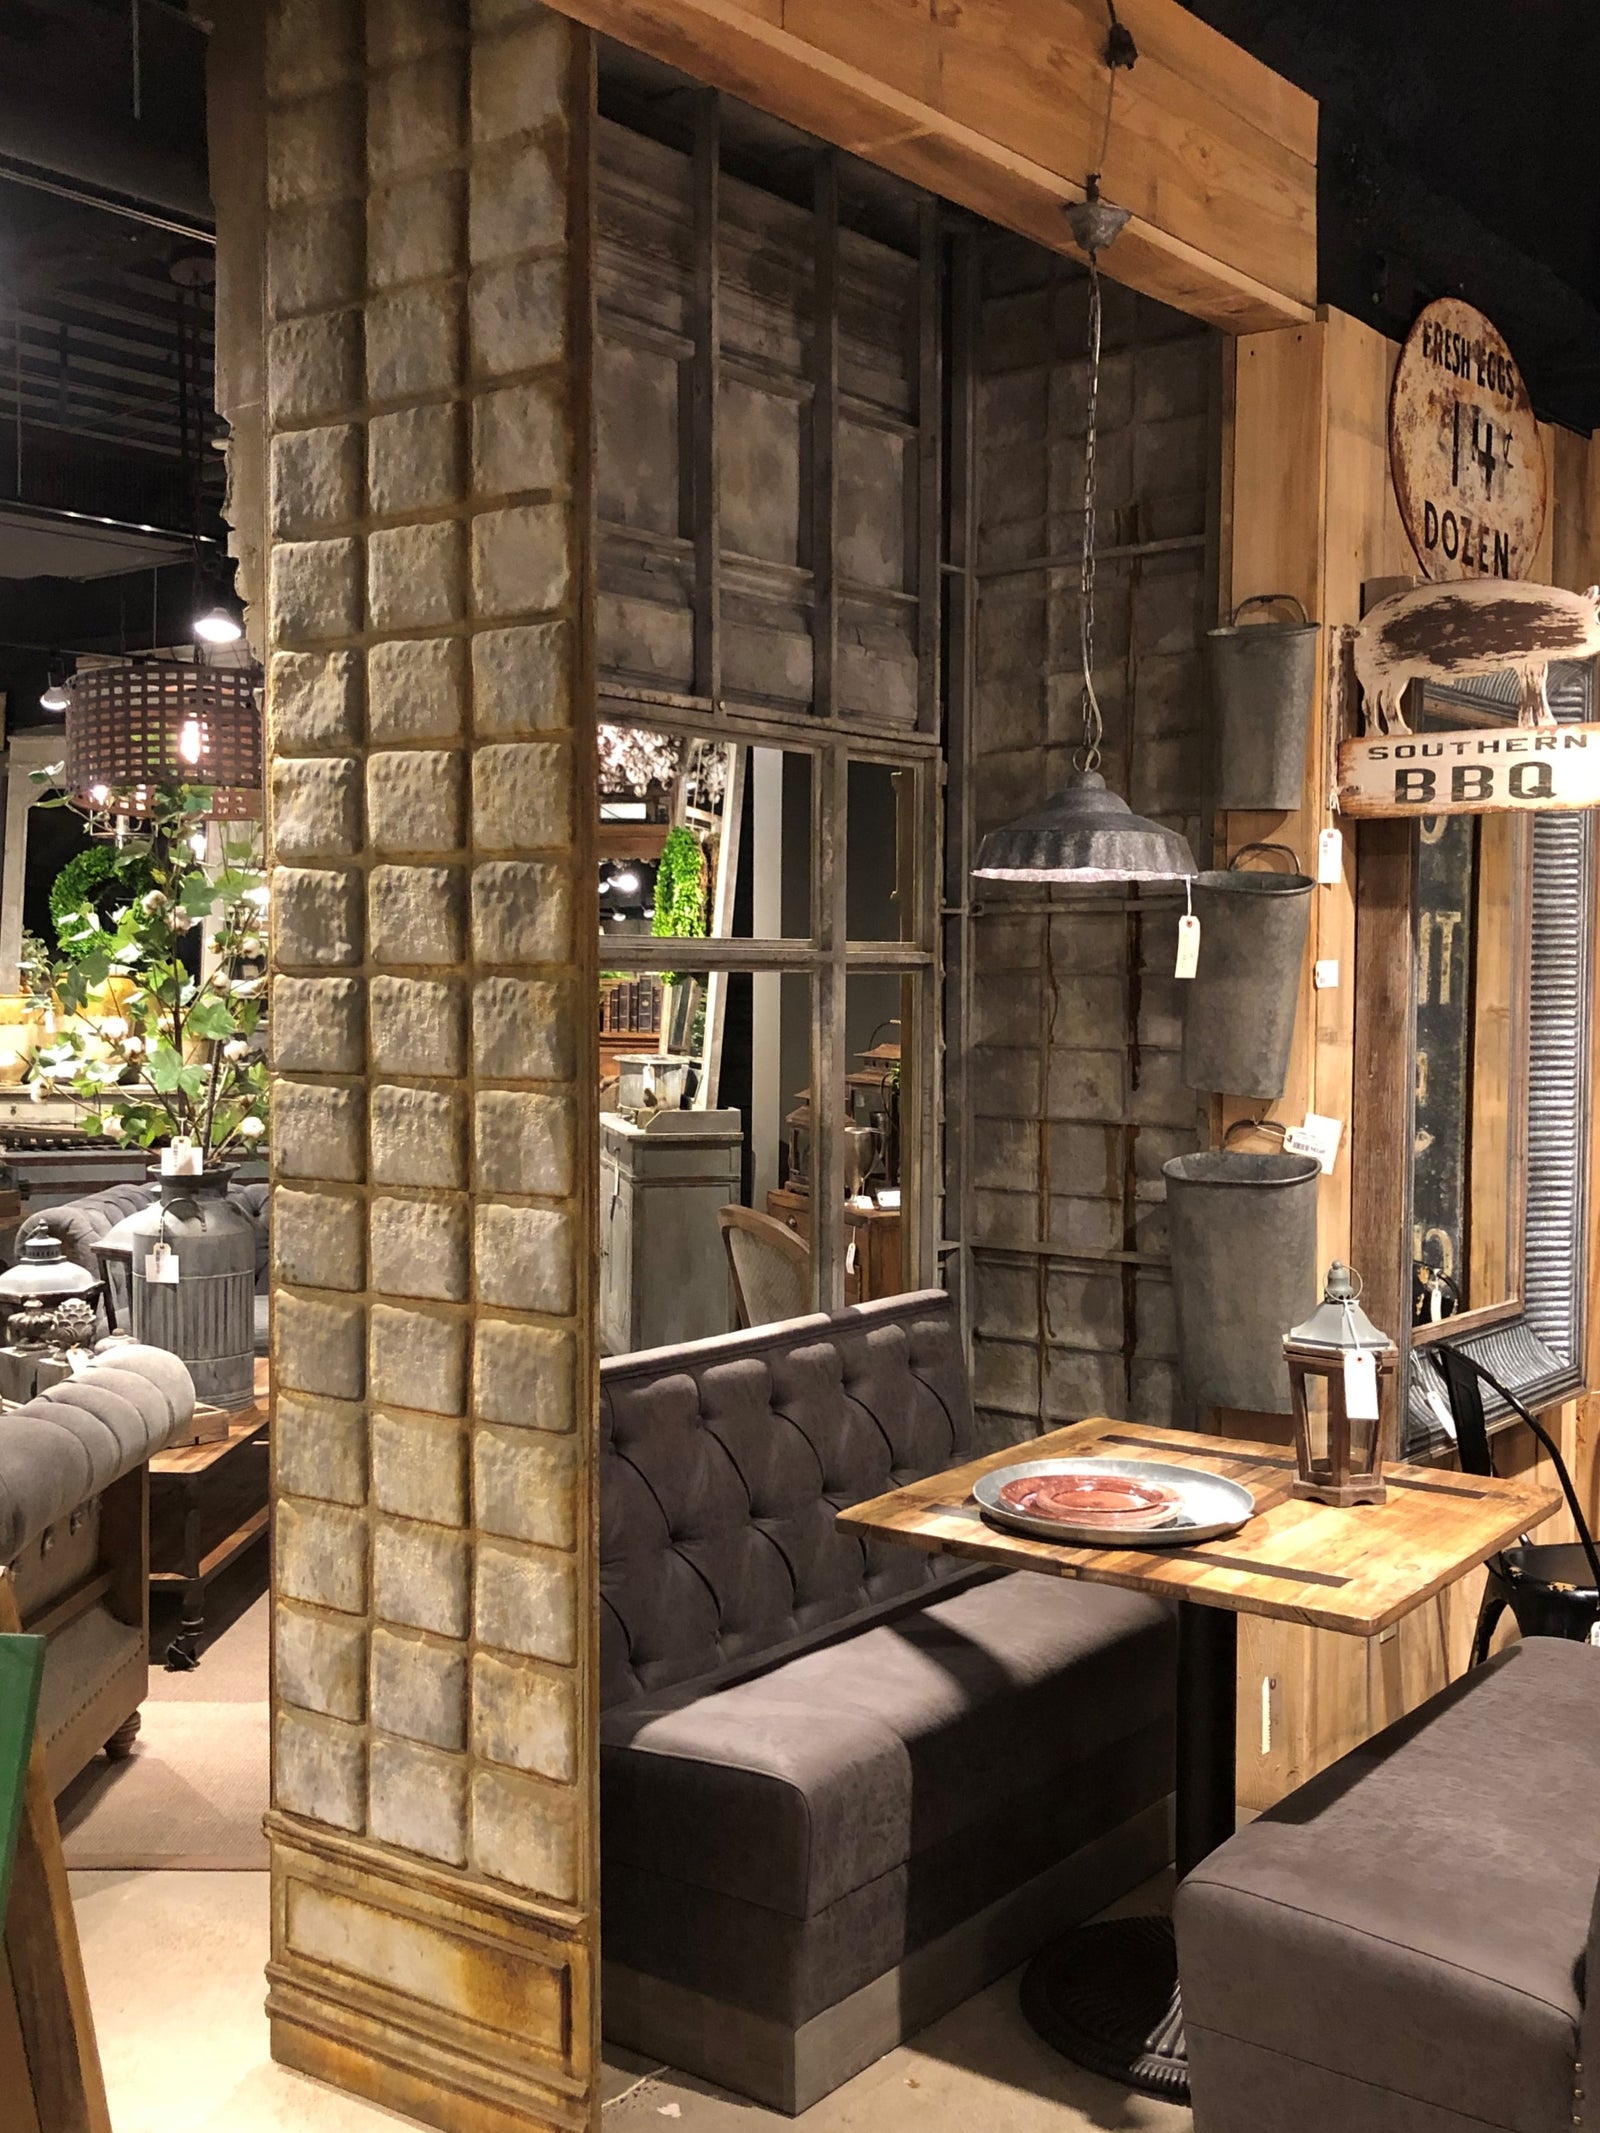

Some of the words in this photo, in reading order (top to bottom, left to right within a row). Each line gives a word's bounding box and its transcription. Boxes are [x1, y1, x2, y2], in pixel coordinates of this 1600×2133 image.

[1422, 319, 1471, 380] FRESH
[1476, 346, 1514, 399] EGGS
[1424, 500, 1508, 579] DOZEN
[1368, 735, 1587, 760] SOUTHERN
[1394, 762, 1557, 803] BBQ
